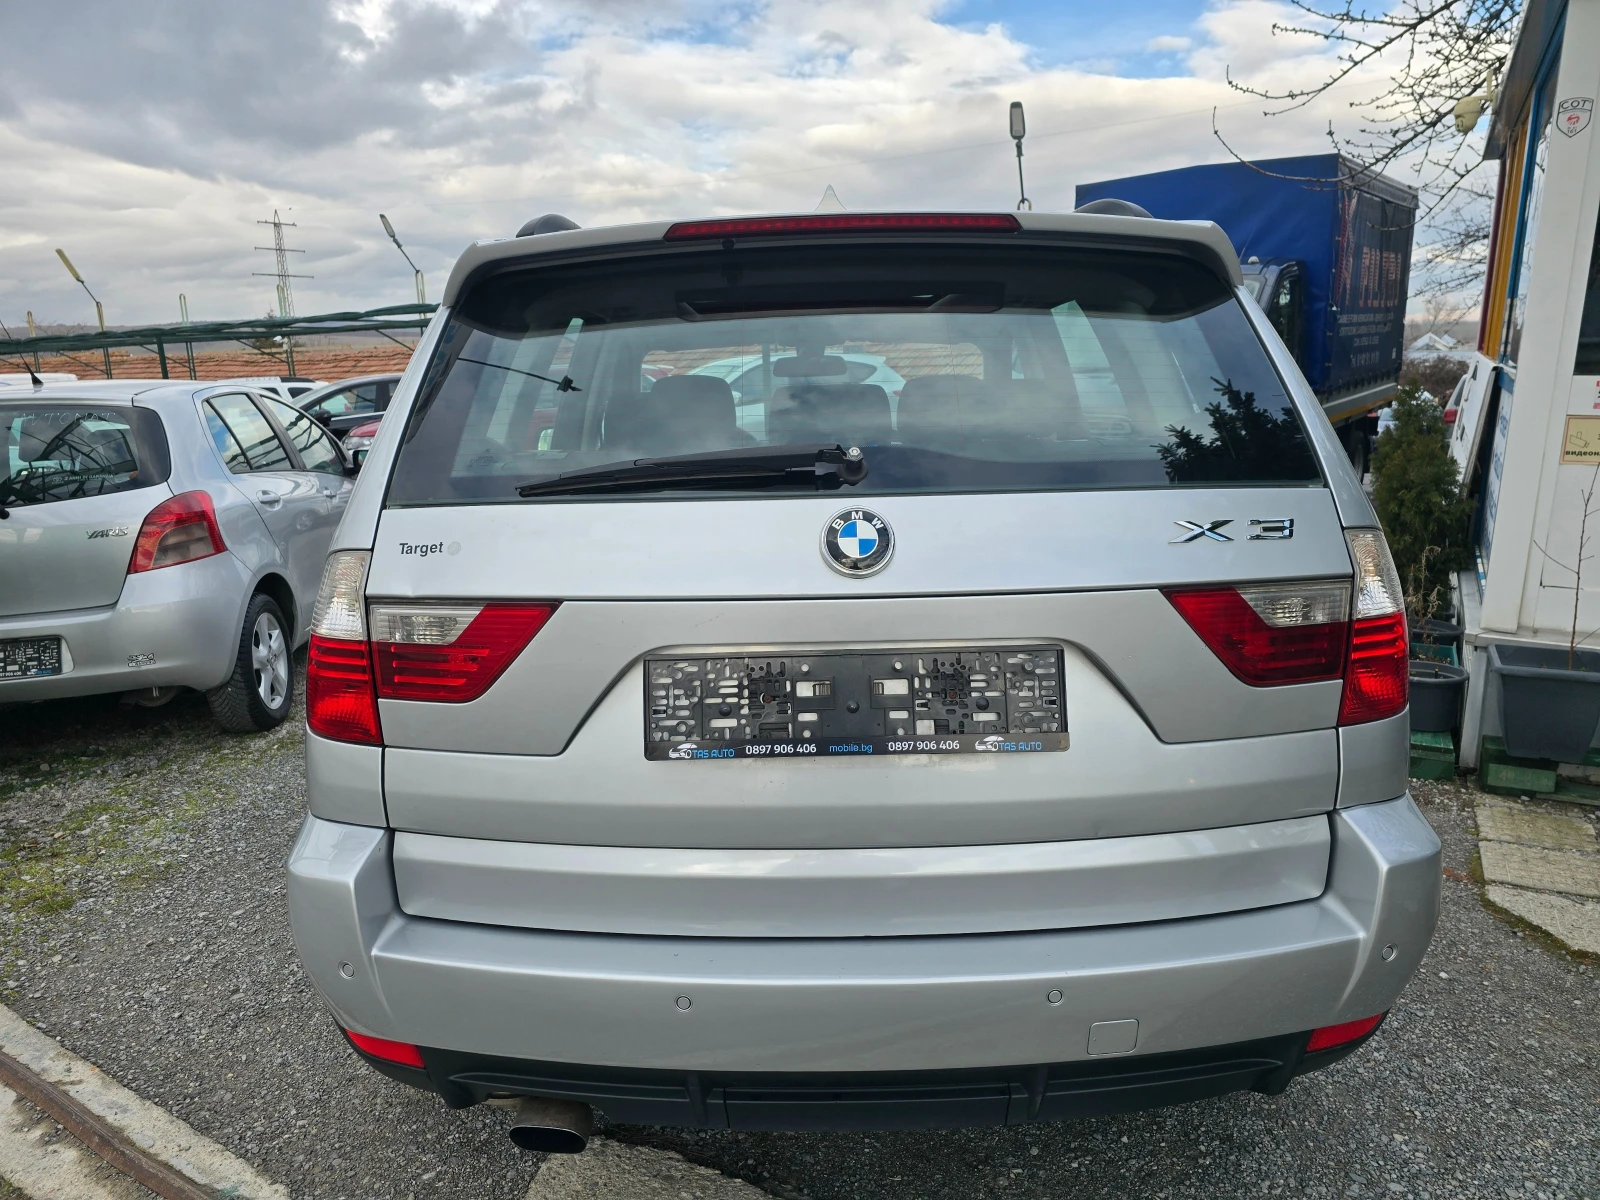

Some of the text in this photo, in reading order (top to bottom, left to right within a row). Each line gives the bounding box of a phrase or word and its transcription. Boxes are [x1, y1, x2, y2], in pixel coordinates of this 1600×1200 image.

[831, 511, 884, 530] BMW
[86, 526, 129, 539] YARIS
[1168, 518, 1295, 544] X3
[399, 541, 444, 558] Target
[692, 740, 1042, 759] TAS AUTO 0897 906 406 mobile.bg 0897 906 406 TAS AUTO
